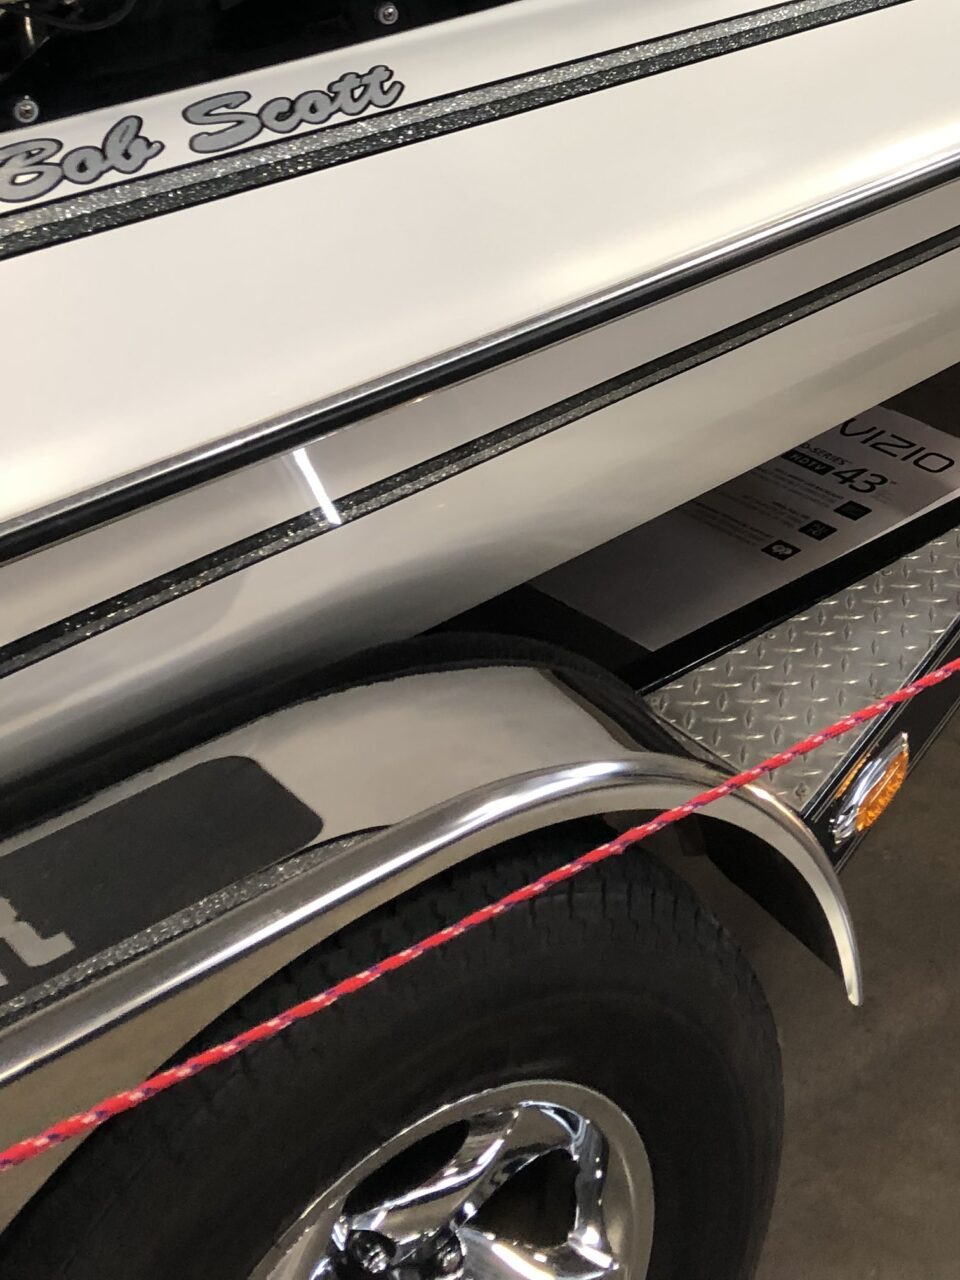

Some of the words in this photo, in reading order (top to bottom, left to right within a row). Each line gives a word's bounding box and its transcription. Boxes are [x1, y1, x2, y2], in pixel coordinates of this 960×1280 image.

[0, 115, 165, 202] Bob
[182, 65, 405, 153] Scott
[838, 417, 955, 473] VIZIO
